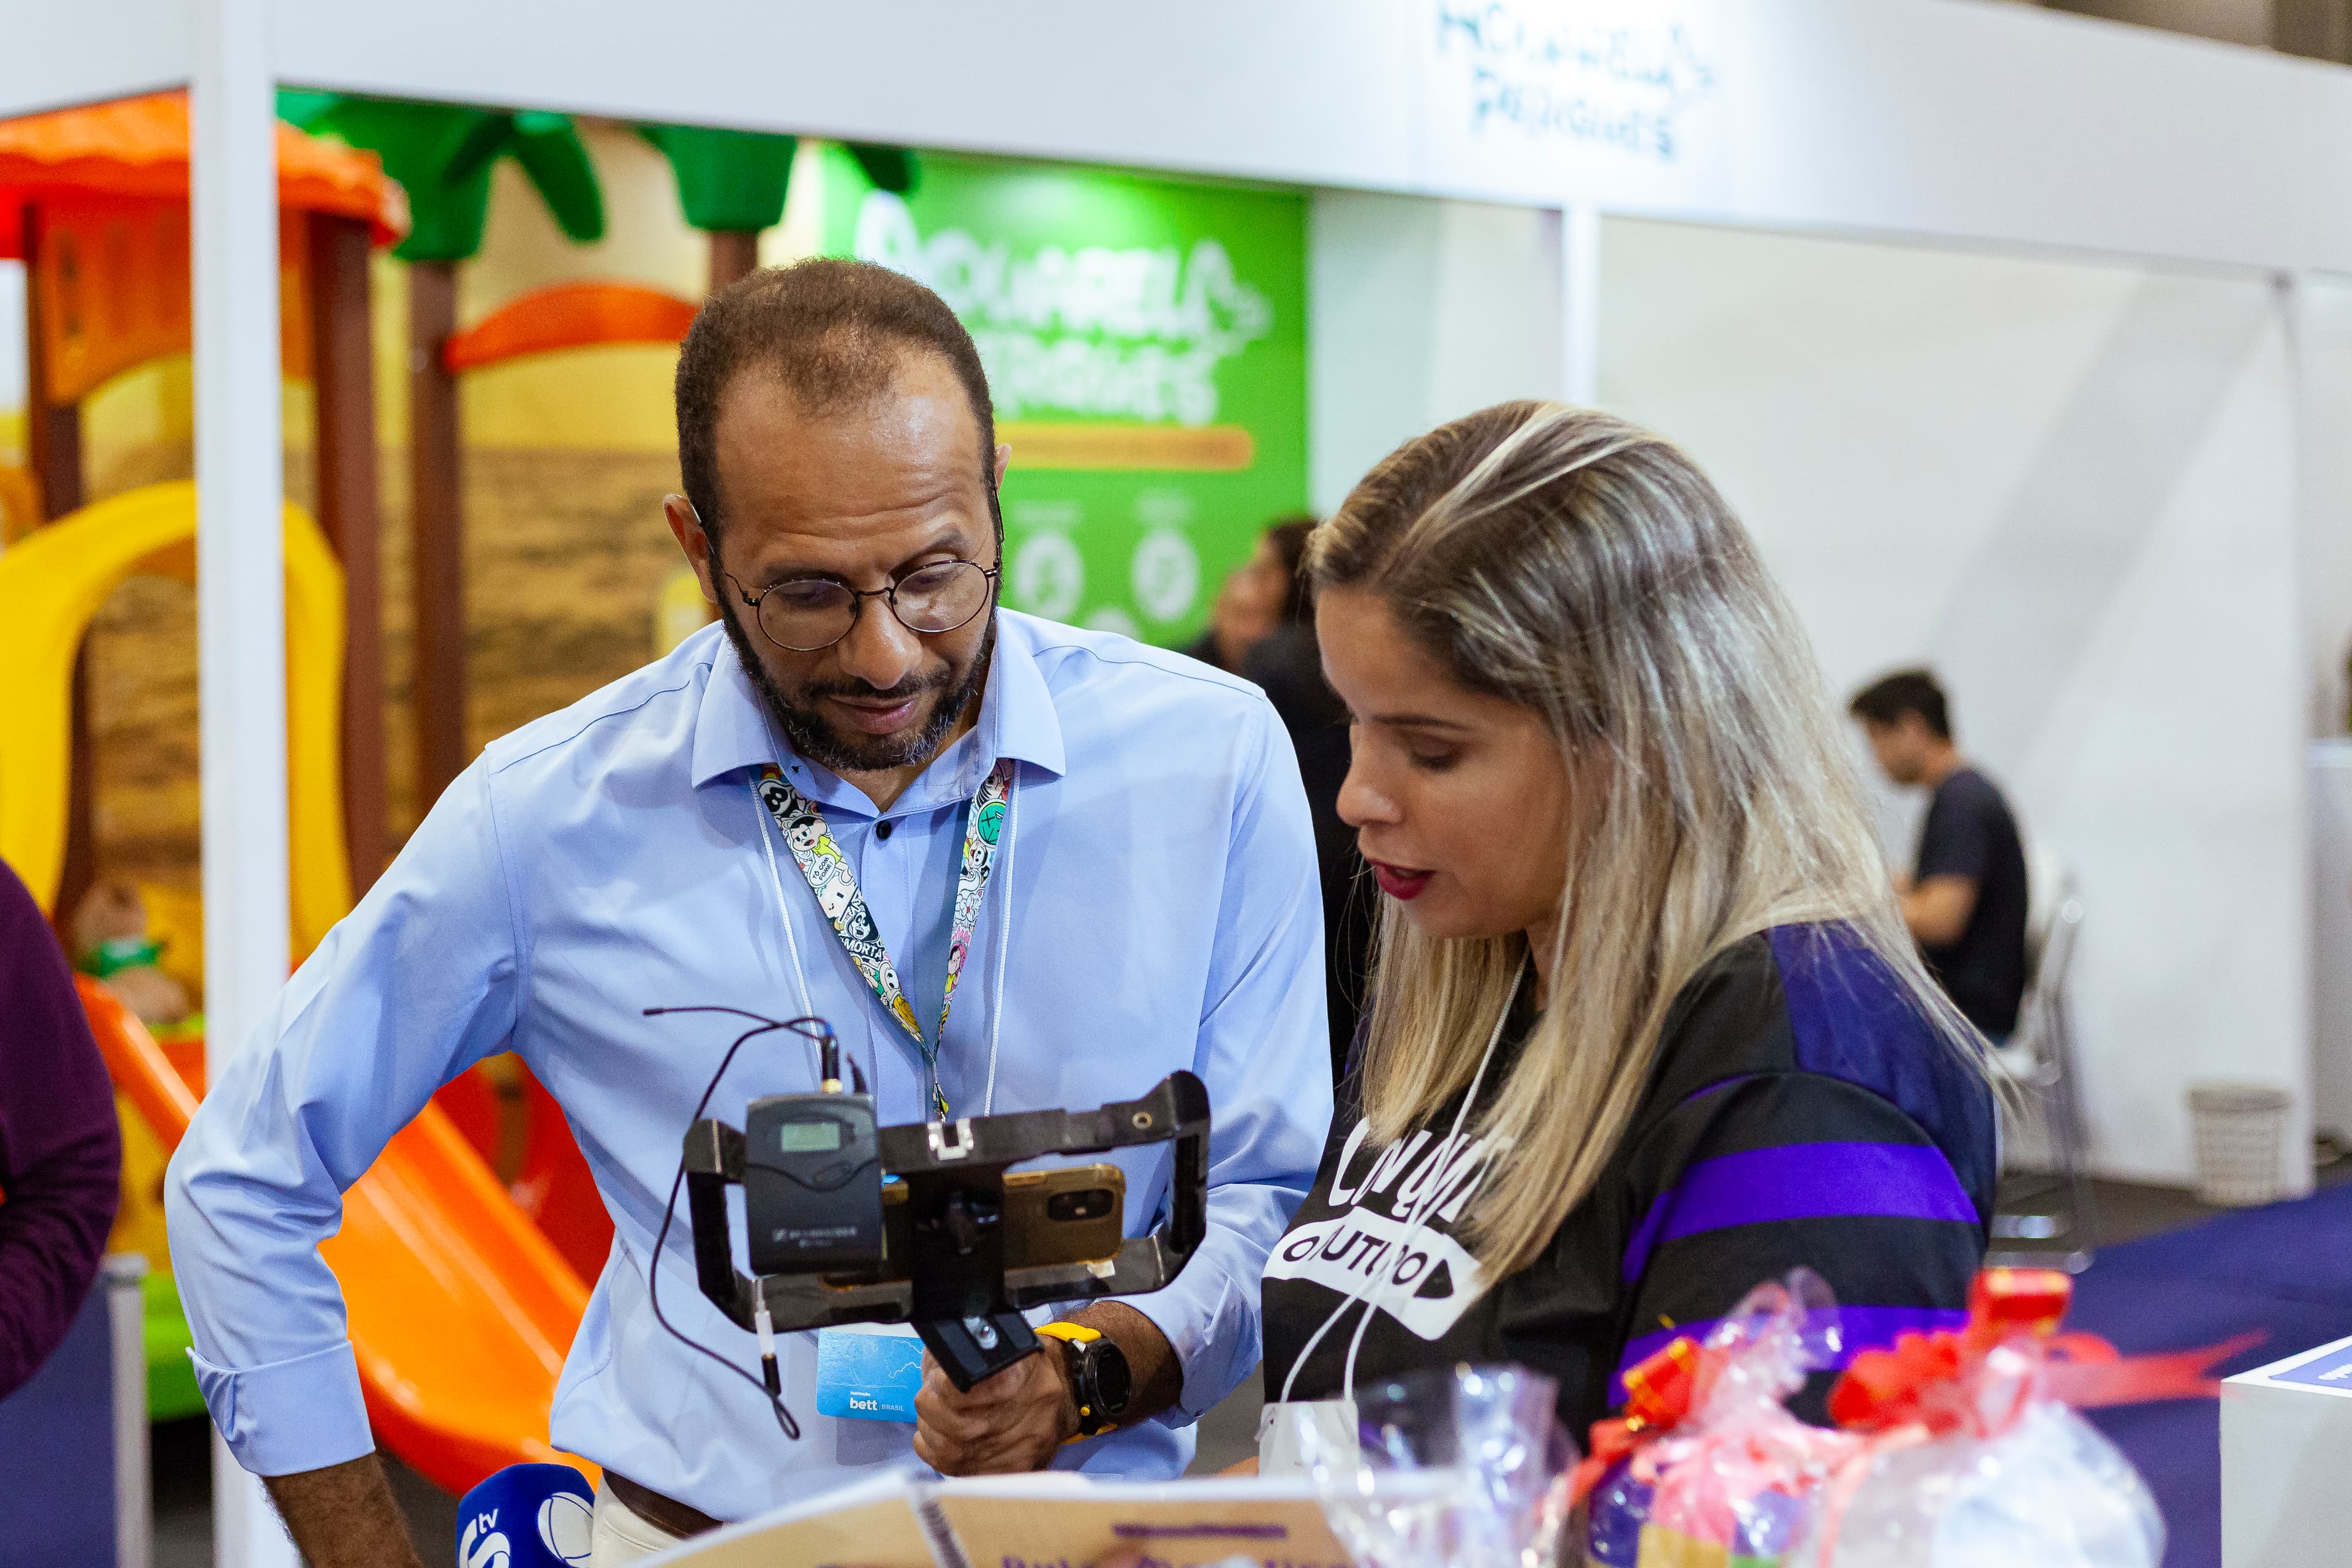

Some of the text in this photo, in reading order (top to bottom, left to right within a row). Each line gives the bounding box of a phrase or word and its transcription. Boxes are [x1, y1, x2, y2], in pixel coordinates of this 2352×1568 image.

[819, 857, 829, 870] COM
[850, 1397, 878, 1411] bett
[479, 1508, 498, 1534] tv
